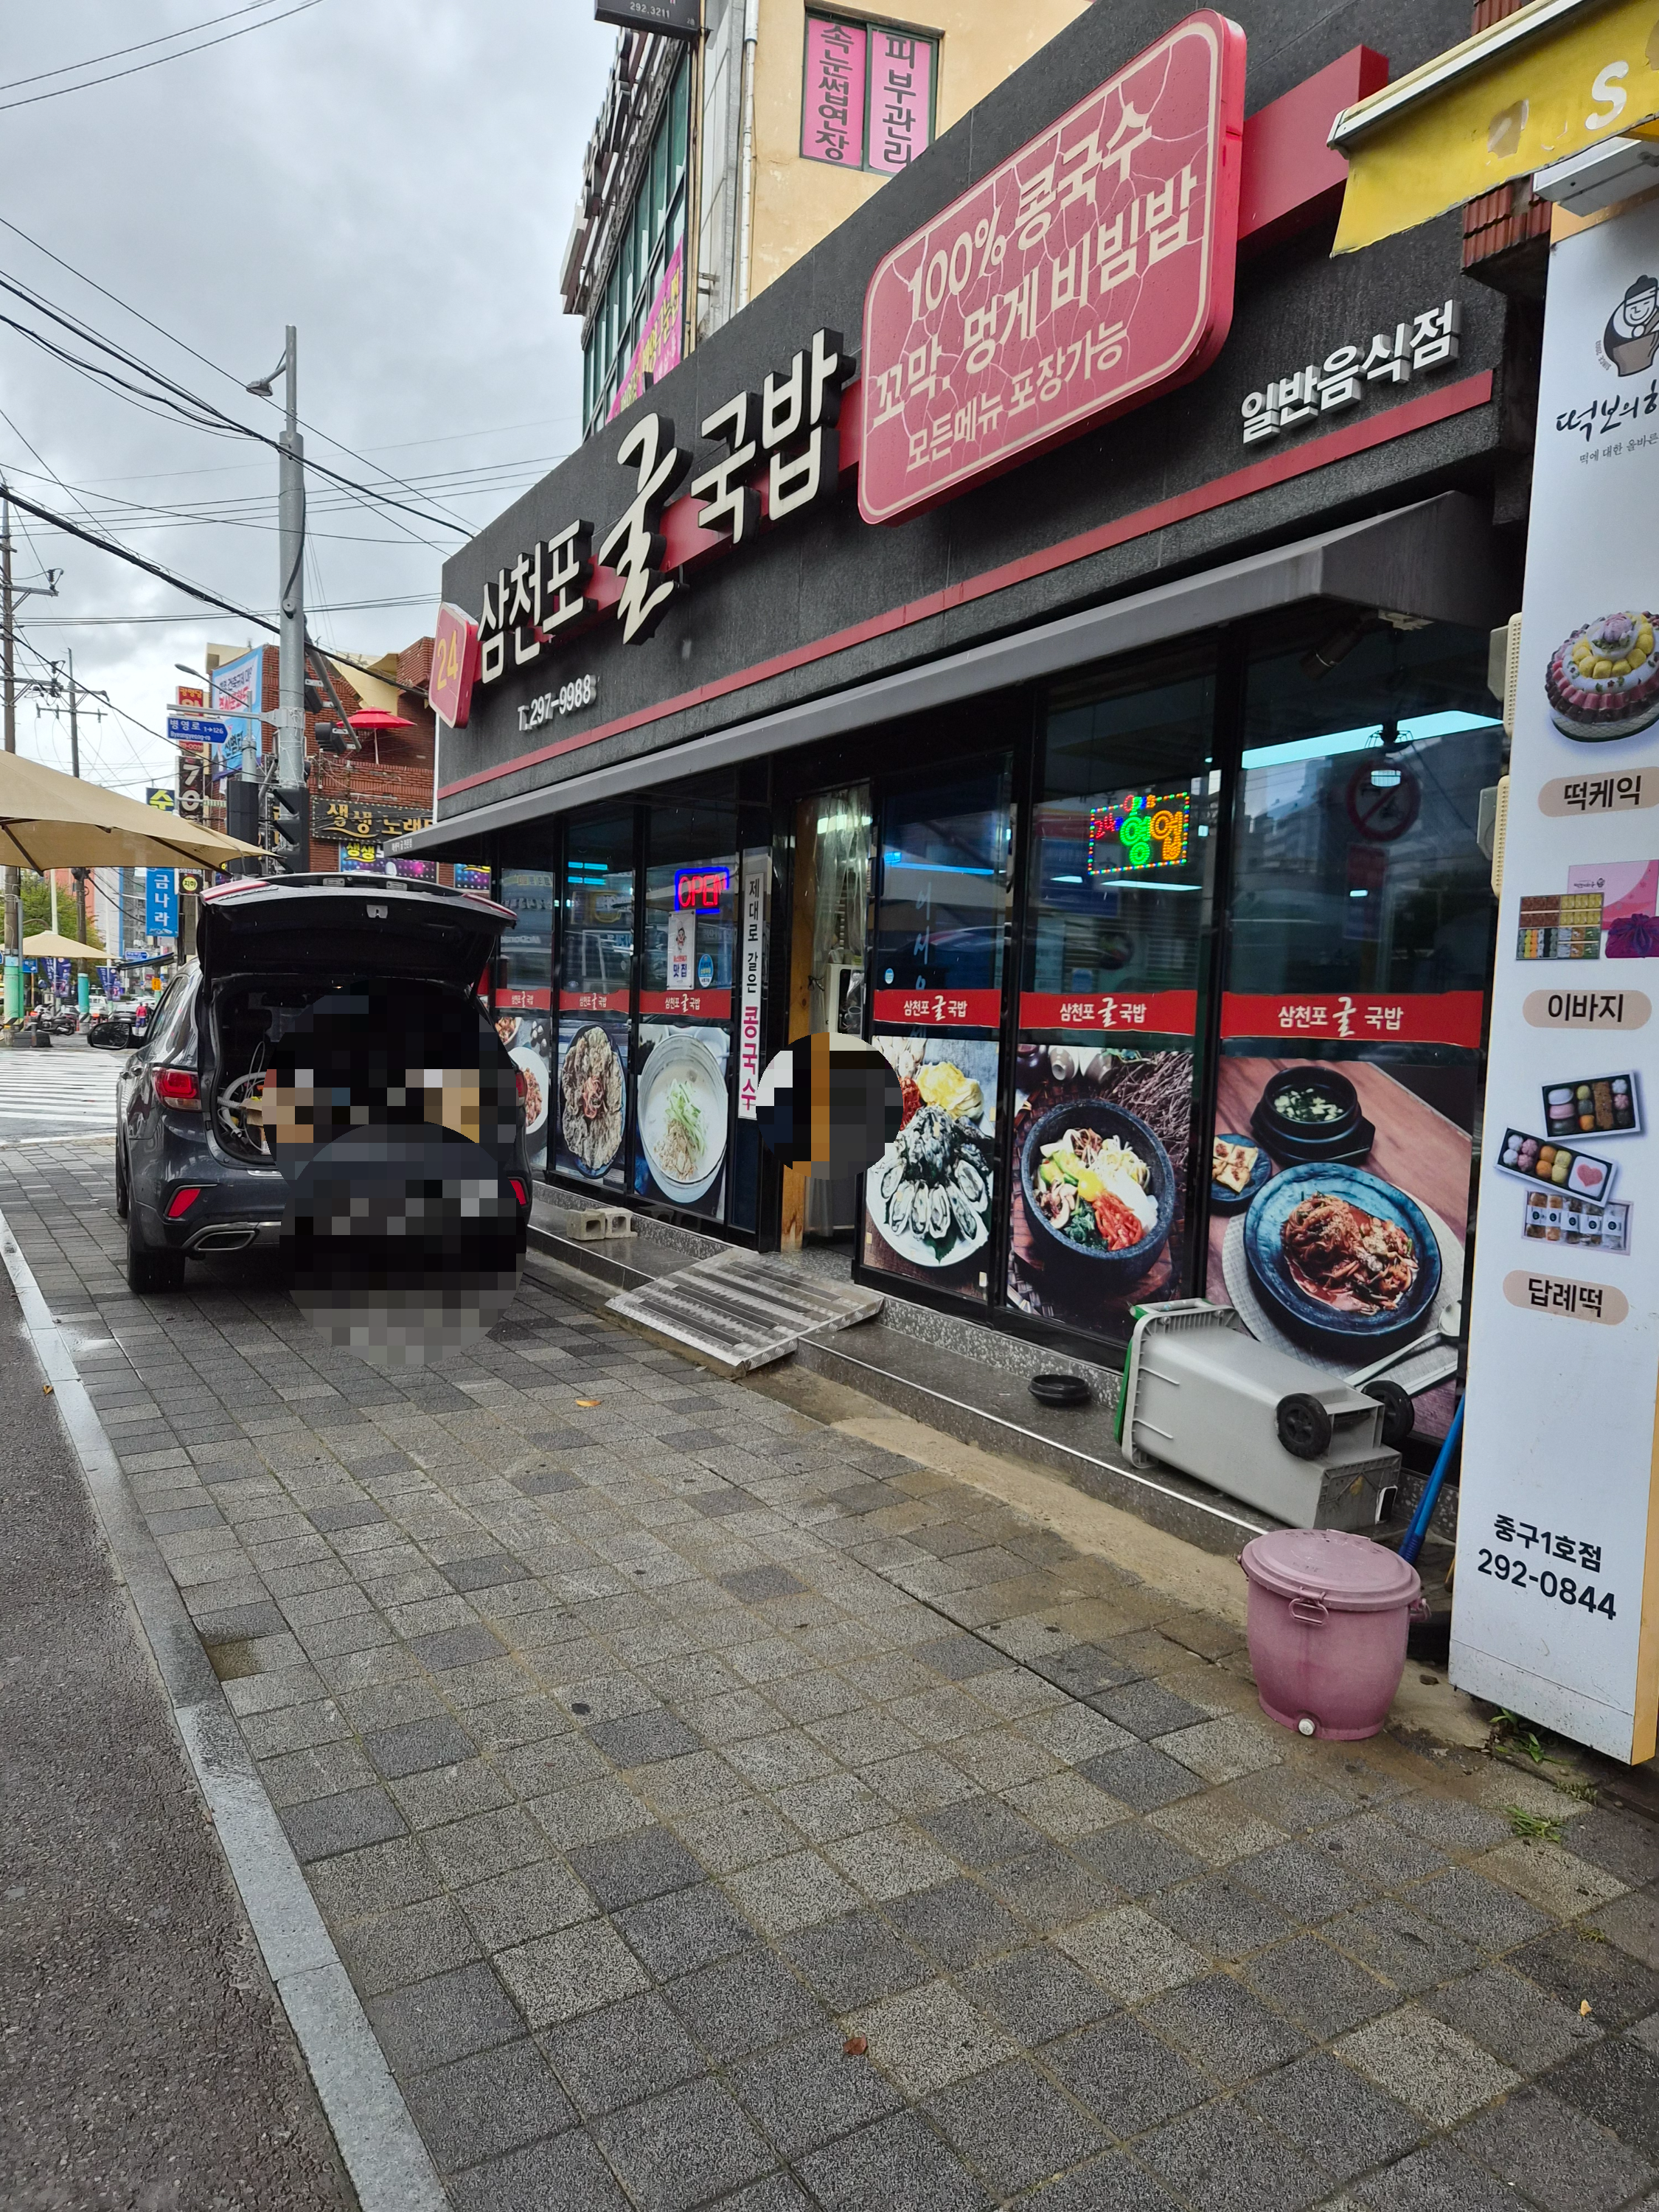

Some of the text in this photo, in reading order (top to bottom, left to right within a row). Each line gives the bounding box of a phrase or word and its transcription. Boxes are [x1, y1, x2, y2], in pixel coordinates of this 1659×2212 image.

[630, 2, 670, 18] 292.3211
[815, 24, 854, 161] 속눈썹연장
[882, 35, 917, 164] 피부관리
[1585, 60, 1630, 131] S
[908, 102, 1152, 322] 100% 콩국수
[873, 164, 1197, 427] 꼬막, 멍게 비빔밥
[906, 319, 1127, 473] 모든메뉴 포장가능
[1241, 298, 1457, 444] 일반음식점
[1580, 449, 1599, 465] 떡에
[1602, 442, 1623, 457] 대한
[477, 519, 584, 684] 삼천포
[690, 327, 838, 545] 국밥
[437, 630, 459, 692] 24
[518, 674, 593, 731] T.297-9988
[327, 803, 372, 835] 생생
[1564, 774, 1642, 810] 떡케익
[346, 842, 375, 860] 생생
[1119, 810, 1183, 866] 영업
[747, 877, 761, 942] 제대로
[673, 964, 687, 978] 맛집
[665, 998, 679, 1010] 삼천포
[689, 998, 700, 1010] 국밥
[904, 1000, 930, 1016] 삼천포
[947, 1000, 967, 1017] 국밥
[1060, 997, 1147, 1027] 삼천포 굴 국밥
[1278, 996, 1404, 1037] 삼천포 굴 국밥
[1548, 992, 1624, 1023] 이바지
[740, 1006, 760, 1111] 콩국수
[1528, 1277, 1603, 1318] 답례떡
[1493, 1513, 1602, 1573] 중구1호점
[1477, 1548, 1617, 1621] 292-0844
